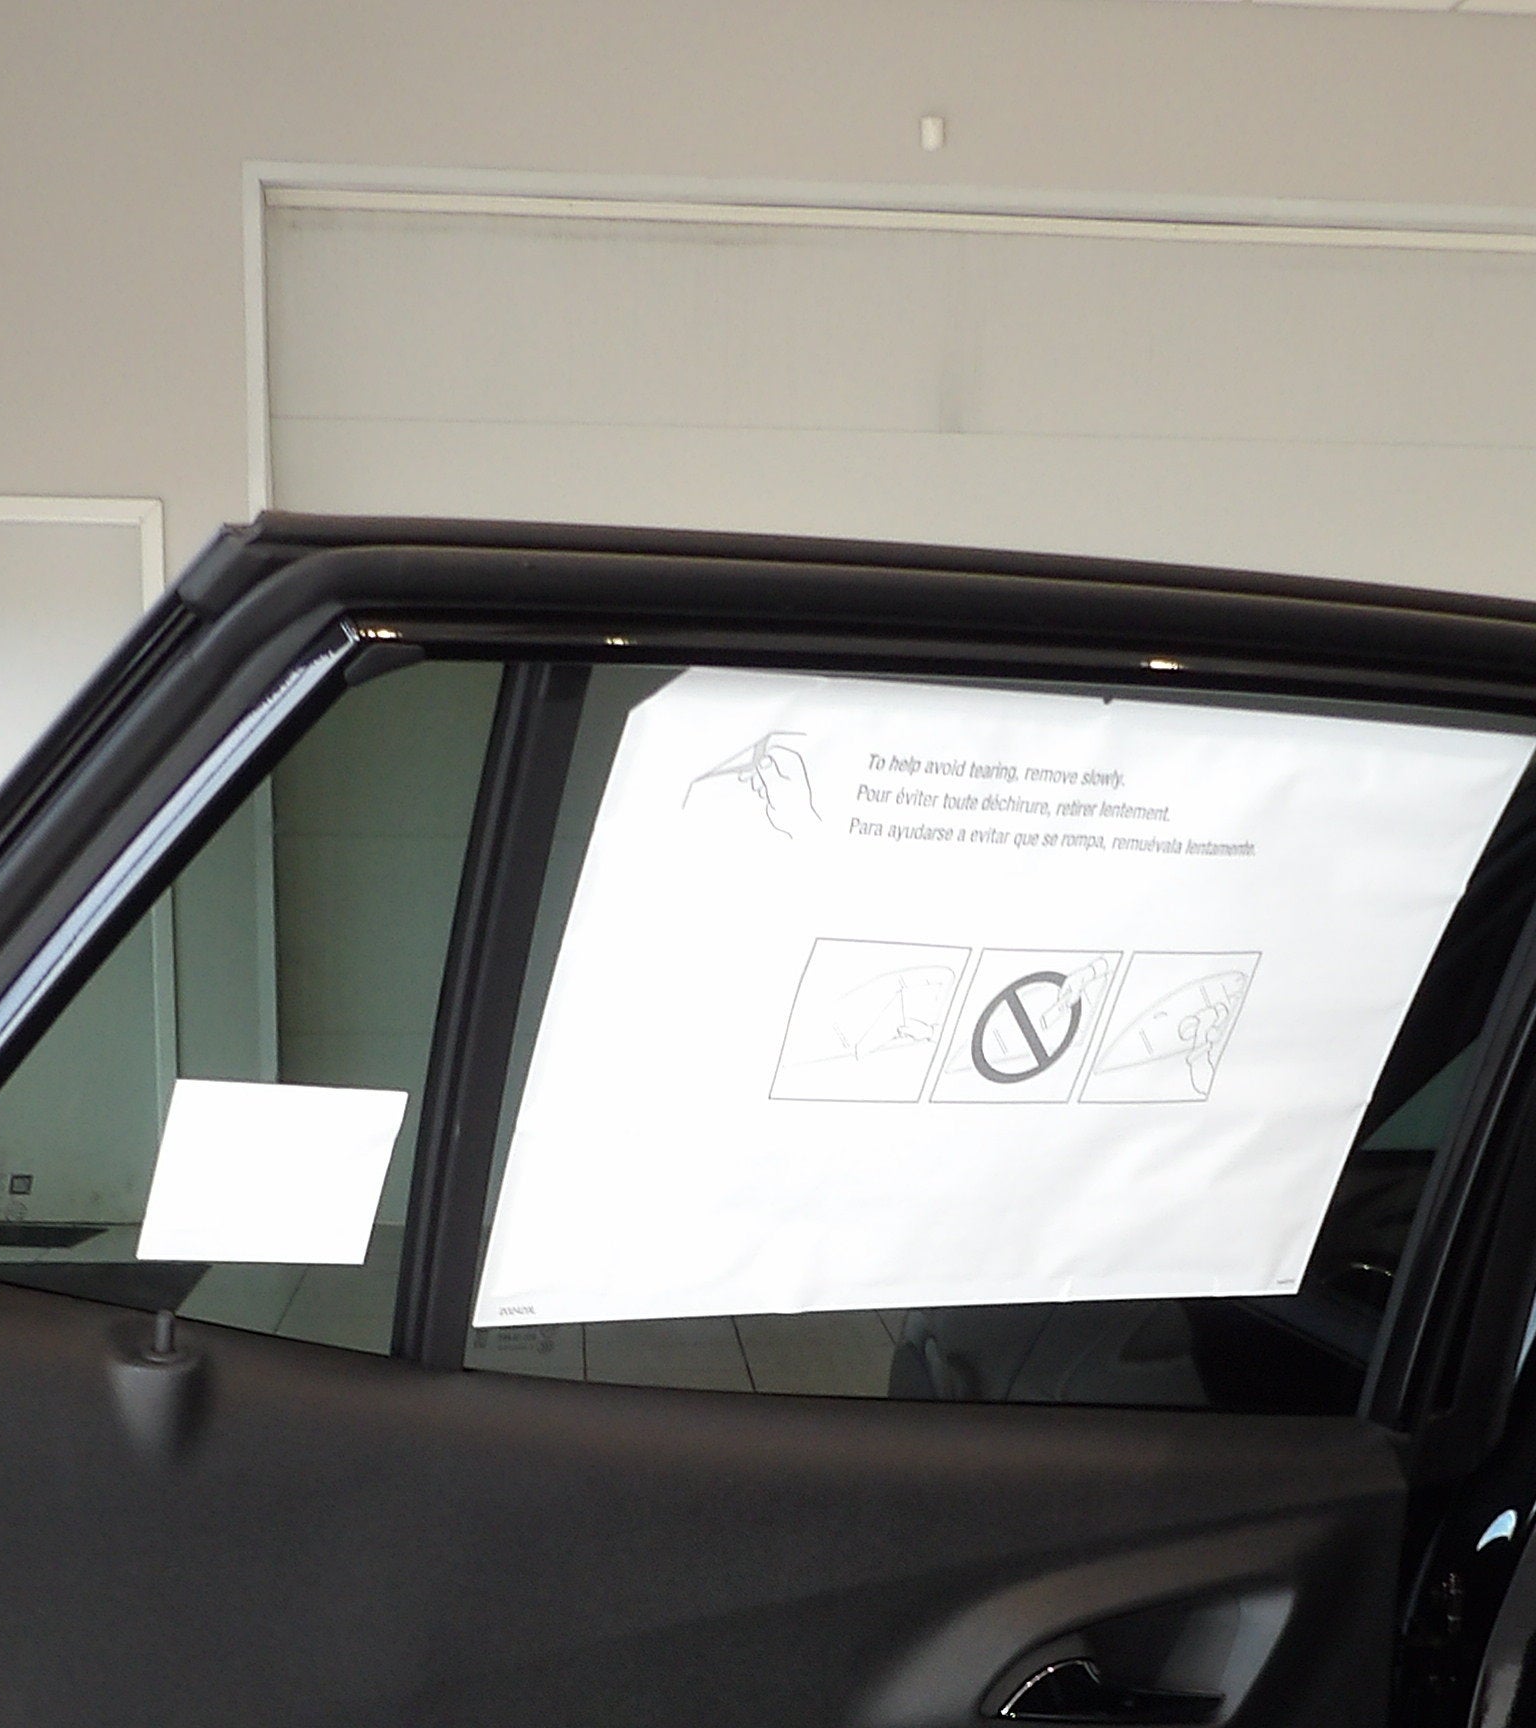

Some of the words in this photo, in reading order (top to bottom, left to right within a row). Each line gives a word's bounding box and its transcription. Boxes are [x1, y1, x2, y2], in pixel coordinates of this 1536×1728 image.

[868, 753, 885, 770] To
[889, 755, 921, 776] help
[924, 759, 967, 777] avoid
[969, 761, 1019, 783] tearing,
[1024, 766, 1078, 785] remove
[856, 784, 892, 803] Pour
[895, 787, 939, 808] éviter
[943, 792, 978, 811] toute
[981, 794, 1051, 818] déchirure,
[1056, 800, 1098, 817] retirer
[1099, 801, 1170, 822] lentement.
[849, 817, 883, 836] Para
[888, 823, 953, 842] ayudarse
[957, 830, 965, 842] a
[970, 827, 1010, 845] evitar
[1013, 832, 1039, 849] que
[1041, 833, 1058, 847] se
[1061, 833, 1106, 851] rompa,
[1112, 836, 1182, 855] remuévala
